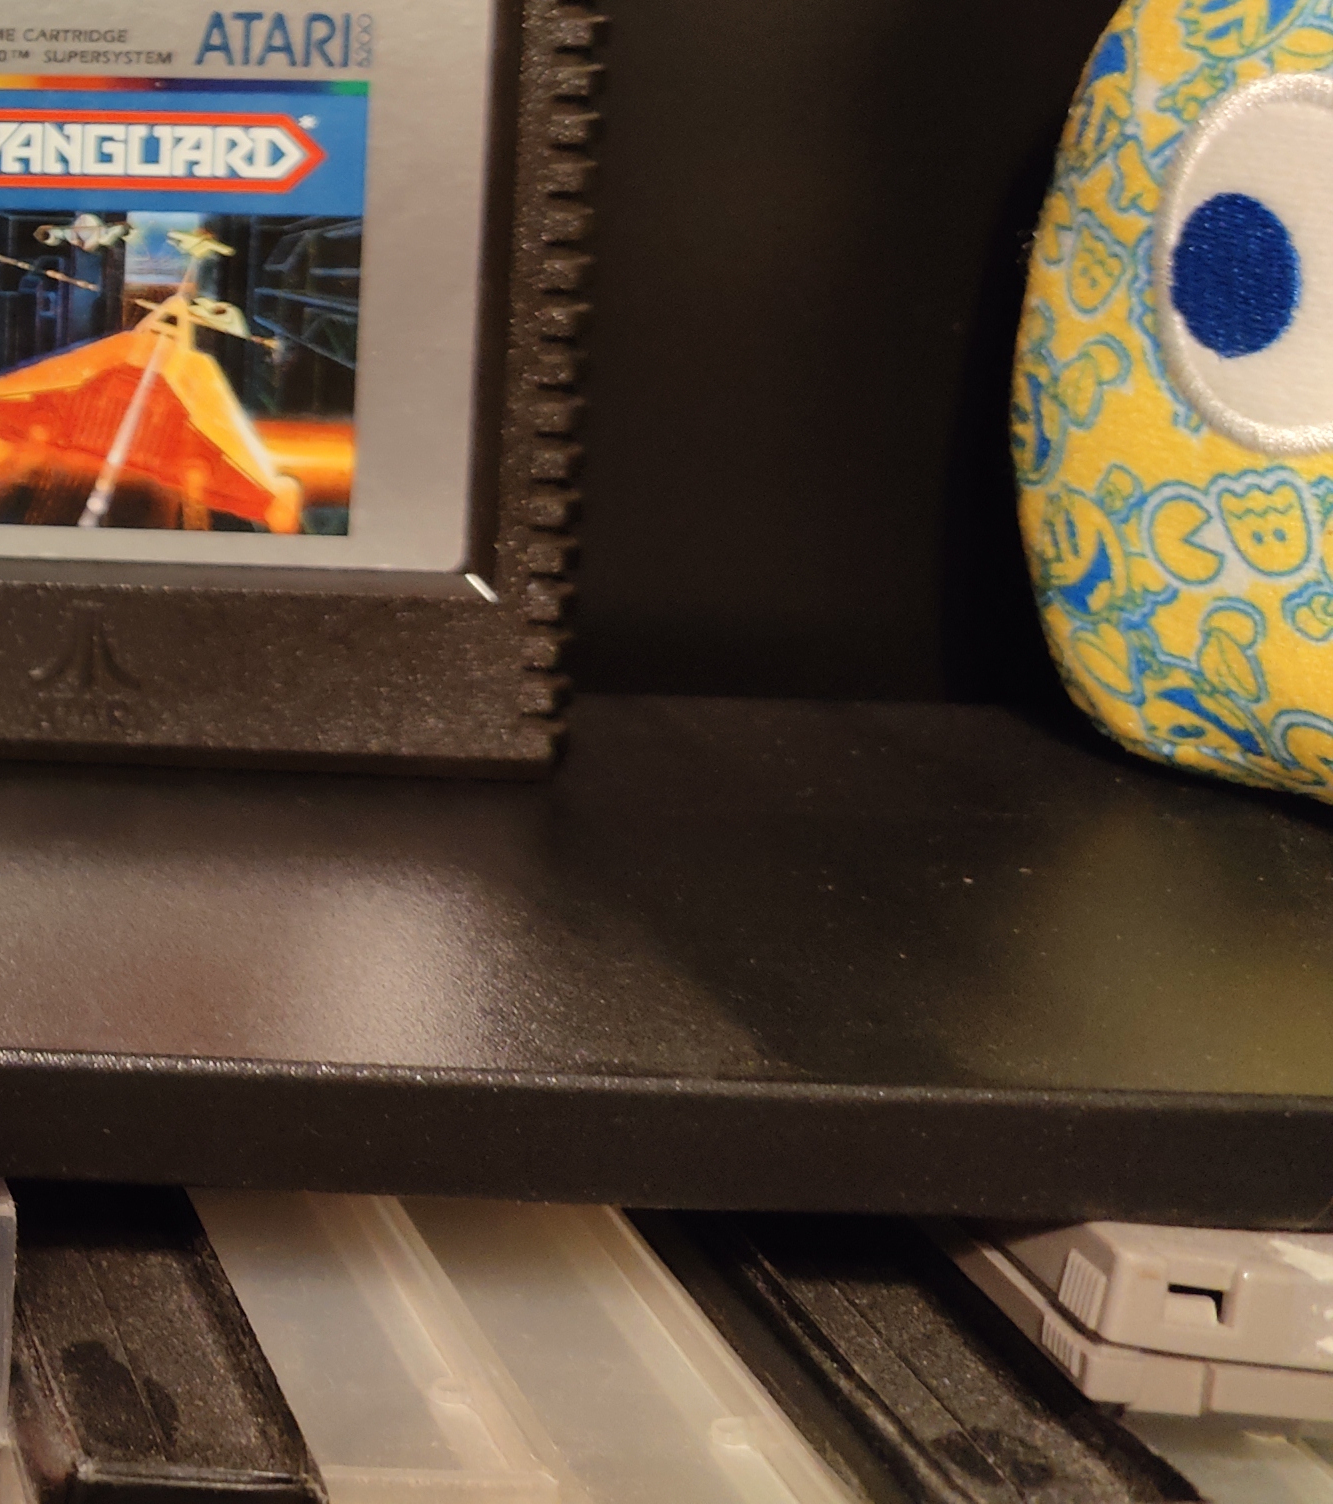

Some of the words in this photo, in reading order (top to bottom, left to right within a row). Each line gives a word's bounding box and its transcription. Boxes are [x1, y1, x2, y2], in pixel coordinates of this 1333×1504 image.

[23, 27, 128, 44] CARTRIDGE
[195, 10, 352, 68] ATARI
[43, 49, 173, 65] SUPERSYSTEM
